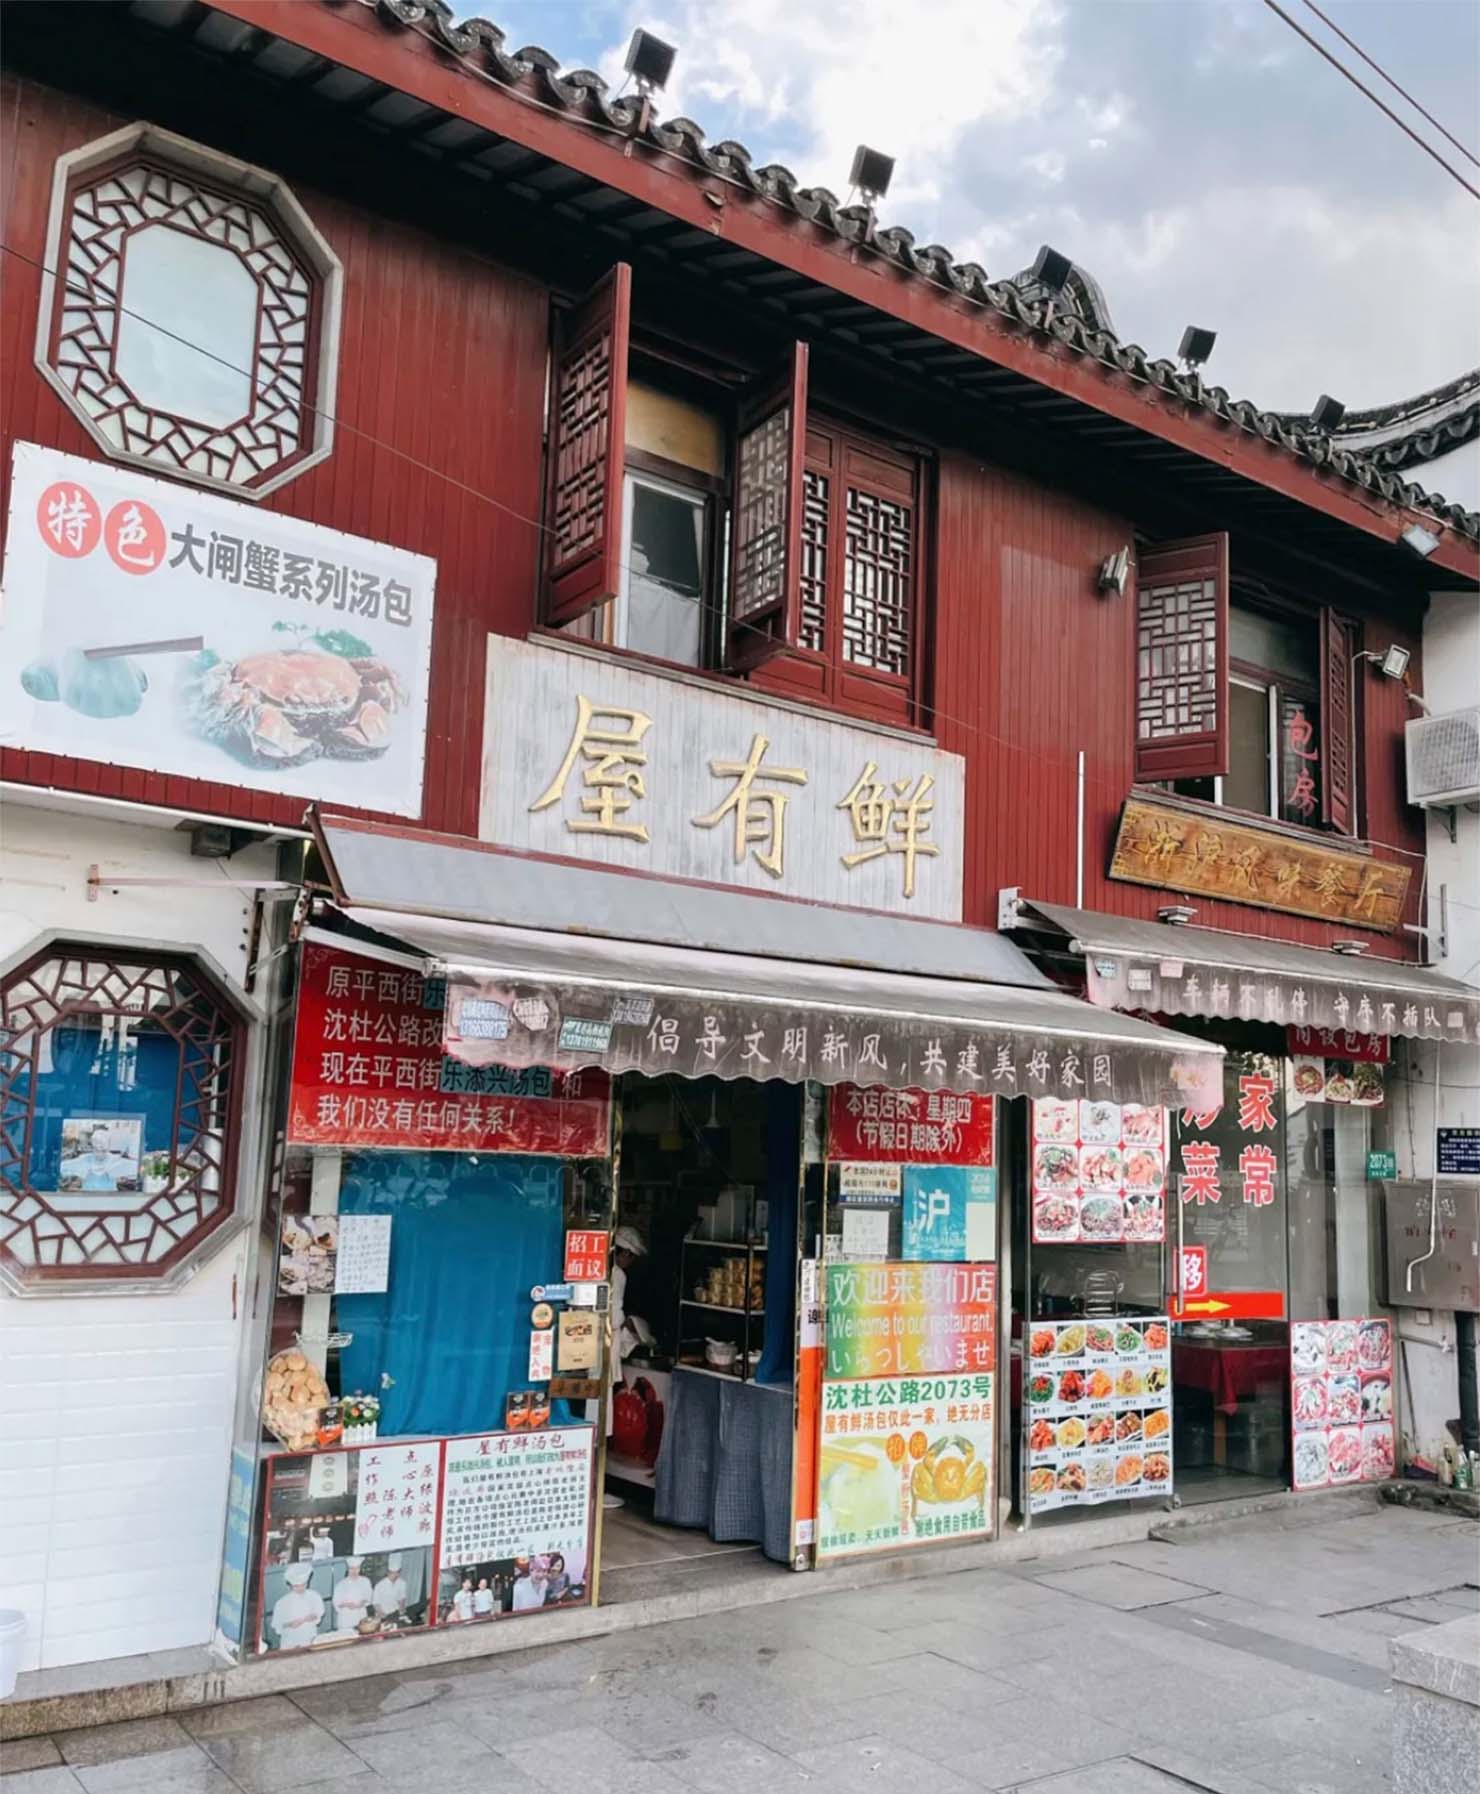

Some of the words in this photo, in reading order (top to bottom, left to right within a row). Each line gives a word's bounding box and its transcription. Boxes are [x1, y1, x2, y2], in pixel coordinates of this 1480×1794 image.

[47, 490, 155, 567] 特色
[168, 523, 413, 627] 大闸蟹系列汤包
[528, 695, 940, 897] 屋有鲜
[316, 1094, 518, 1135] 我们没有任何关系！
[1239, 1072, 1278, 1207] 家常
[915, 1188, 951, 1236] 沪
[568, 1235, 605, 1254] 招工
[566, 1258, 602, 1277] 面议
[831, 1311, 889, 1339] Welcome
[893, 1313, 905, 1337] to
[826, 1376, 992, 1410] 沈杜公路2073号
